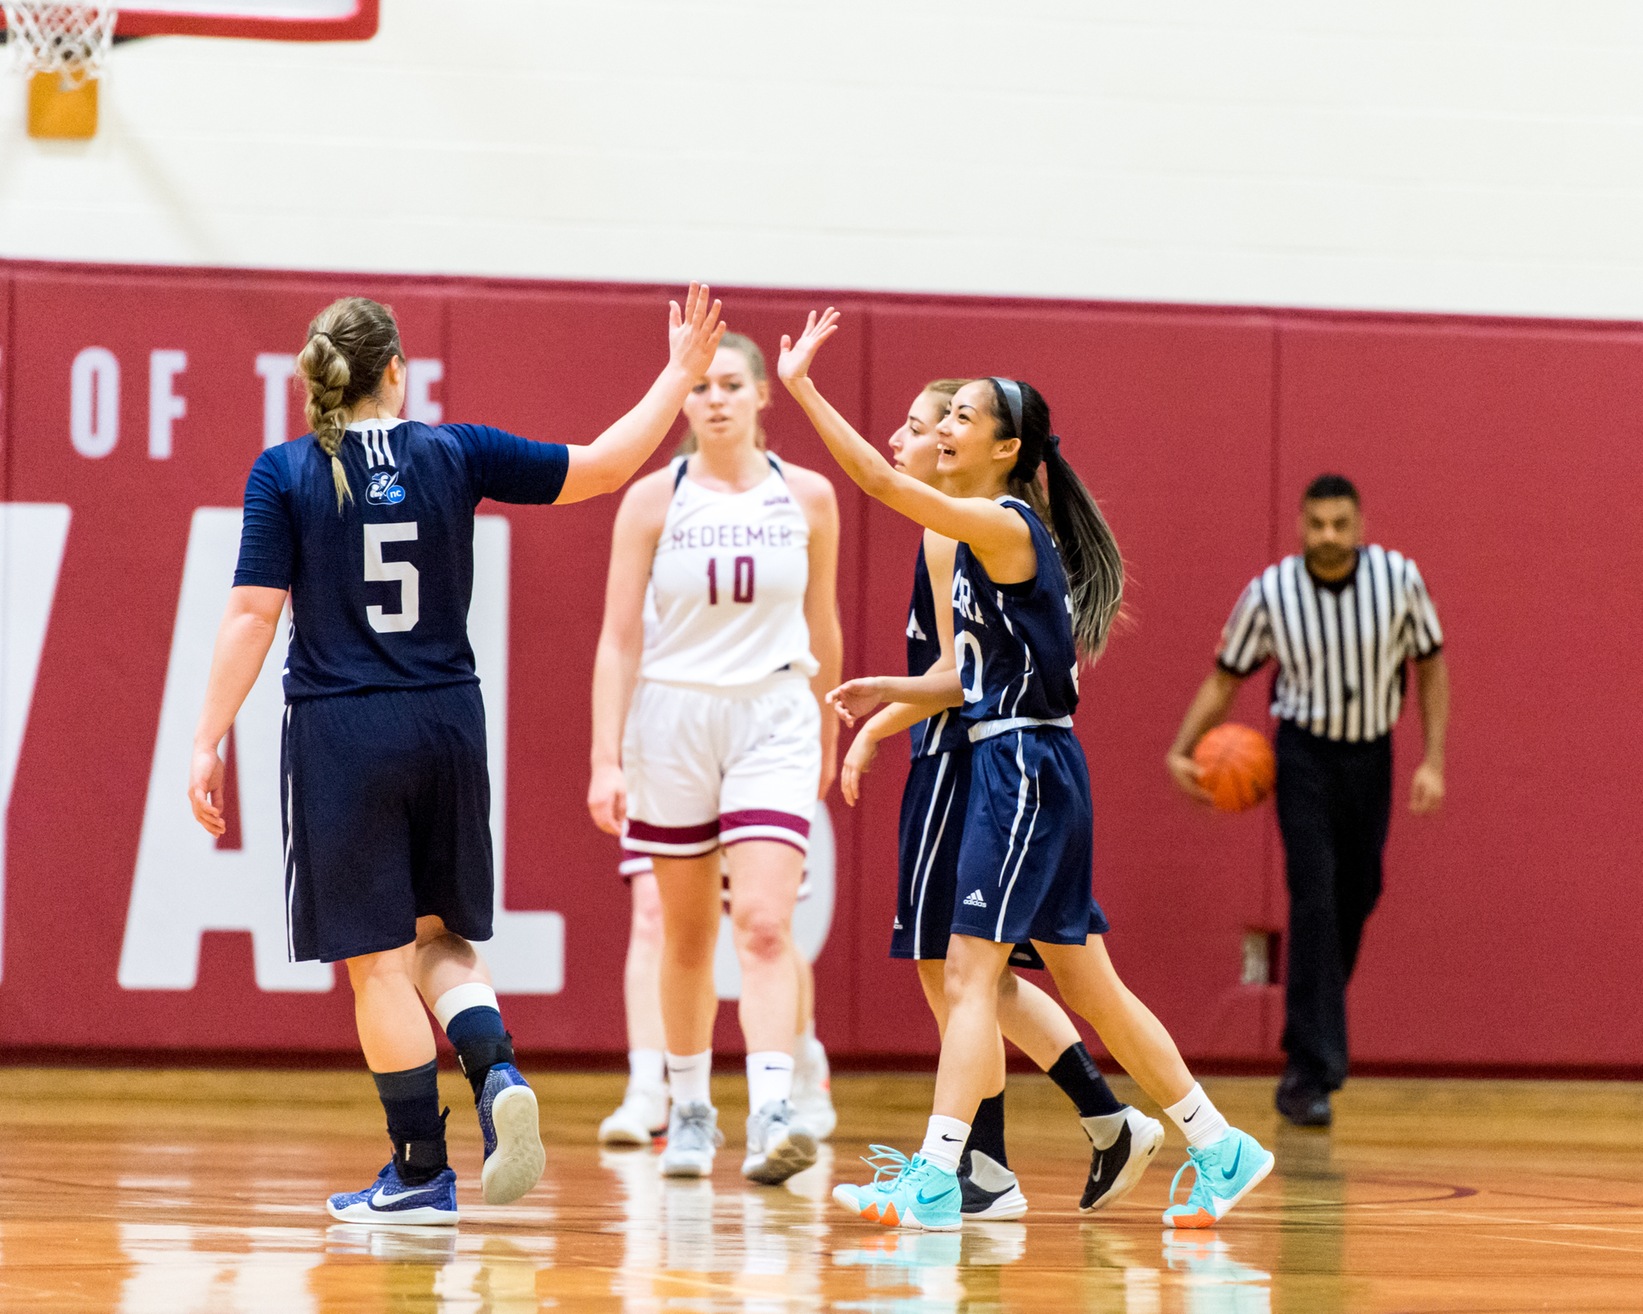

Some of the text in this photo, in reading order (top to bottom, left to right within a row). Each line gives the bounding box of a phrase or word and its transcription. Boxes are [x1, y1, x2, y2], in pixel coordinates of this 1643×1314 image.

[71, 346, 188, 459] OF
[390, 489, 402, 498] nc
[671, 525, 792, 550] REDEEMER
[363, 521, 419, 633] 5
[706, 555, 755, 605] 10
[963, 899, 987, 908] adidas
